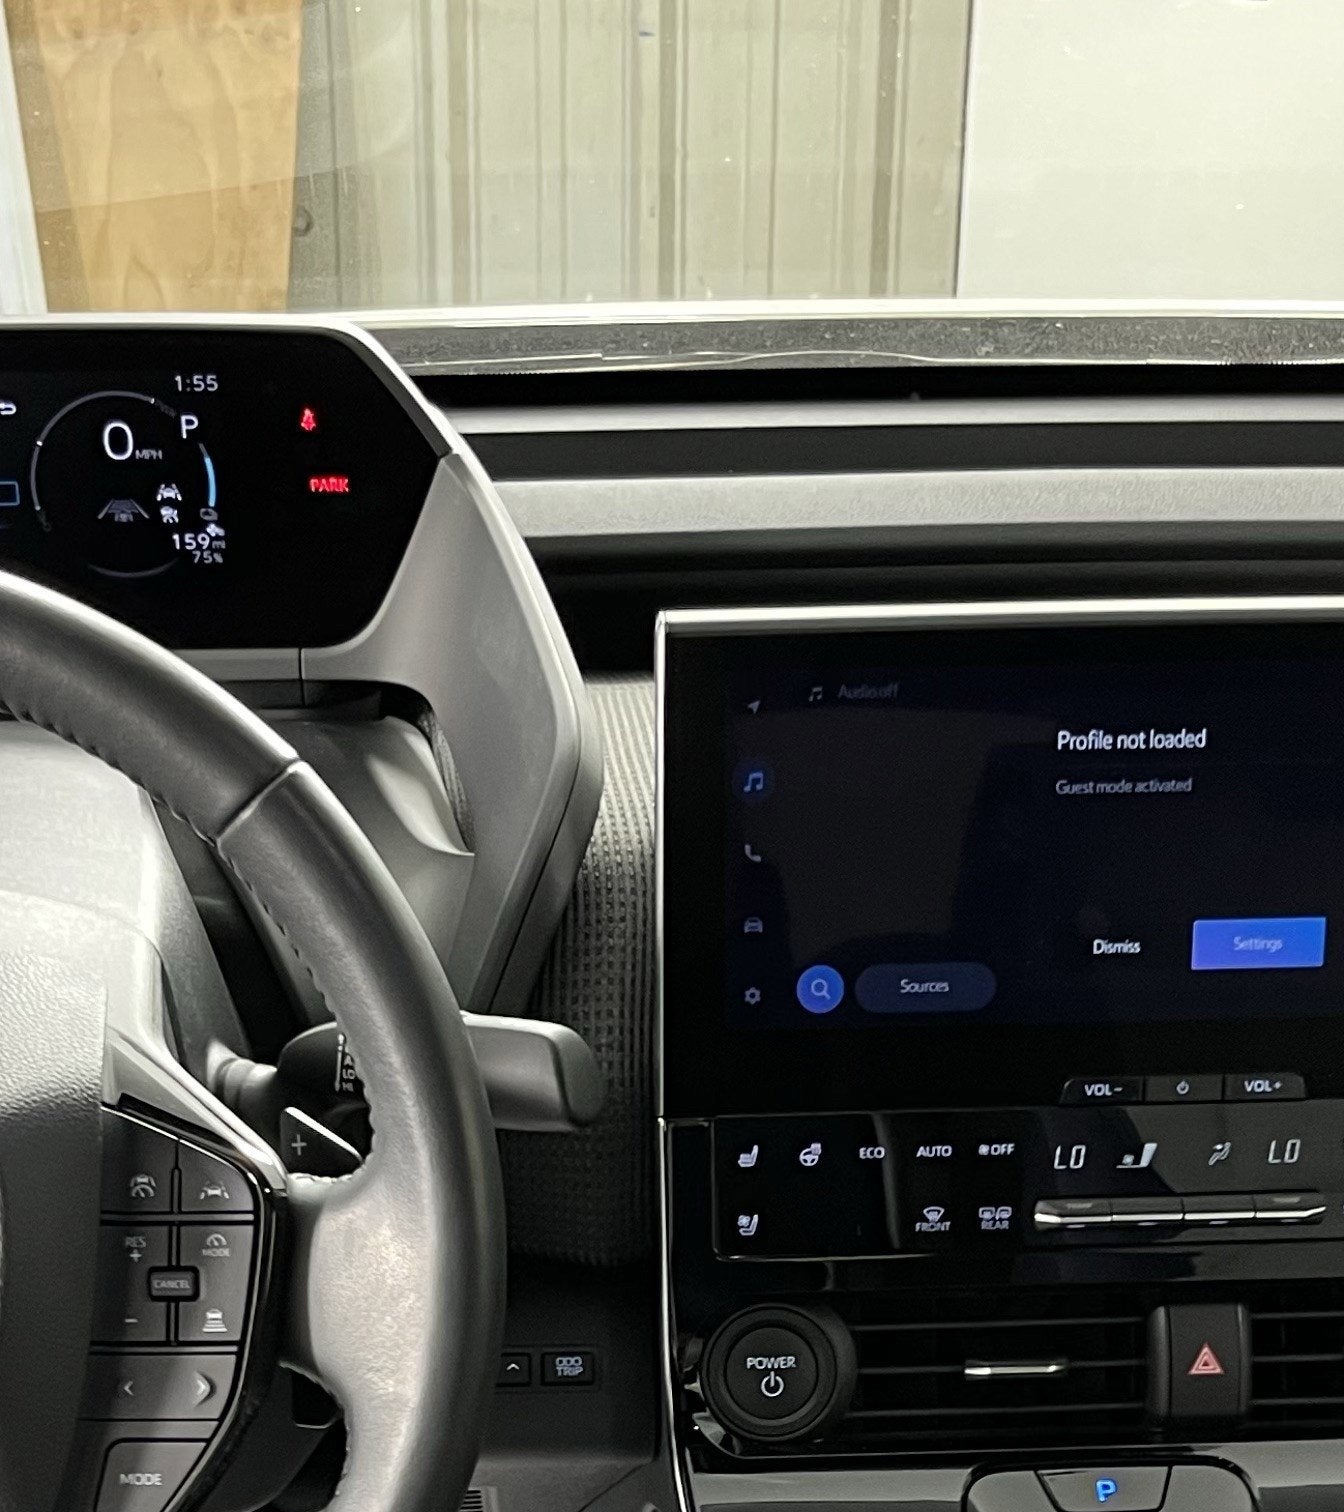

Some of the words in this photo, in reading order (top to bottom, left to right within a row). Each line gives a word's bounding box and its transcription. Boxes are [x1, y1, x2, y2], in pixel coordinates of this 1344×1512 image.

[174, 374, 218, 392] 1:55
[180, 414, 199, 439] P
[135, 449, 163, 461] MPH
[309, 476, 349, 493] PARK
[172, 533, 210, 550] 159
[192, 550, 224, 563] 75%
[1057, 729, 1113, 750] Profile
[1116, 731, 1146, 750] not
[1149, 728, 1206, 749] loaded
[1056, 779, 1094, 794] Guest
[1096, 779, 1133, 794] mode
[1135, 777, 1193, 793] activated
[1093, 939, 1141, 954] Dismiss
[1233, 934, 1283, 953] Settings
[900, 978, 950, 994] Sources
[859, 1147, 885, 1160] ECO
[916, 1145, 953, 1158] AUTO
[991, 1143, 1015, 1156] OFF
[915, 1221, 950, 1233] FRONT
[981, 1218, 1010, 1230] REAR
[154, 1279, 191, 1289] CANCEL
[556, 1355, 583, 1368] ODO
[746, 1356, 797, 1370] POWER
[556, 1366, 584, 1378] TRIP
[119, 1472, 163, 1487] MODE
[1095, 1478, 1119, 1503] P
